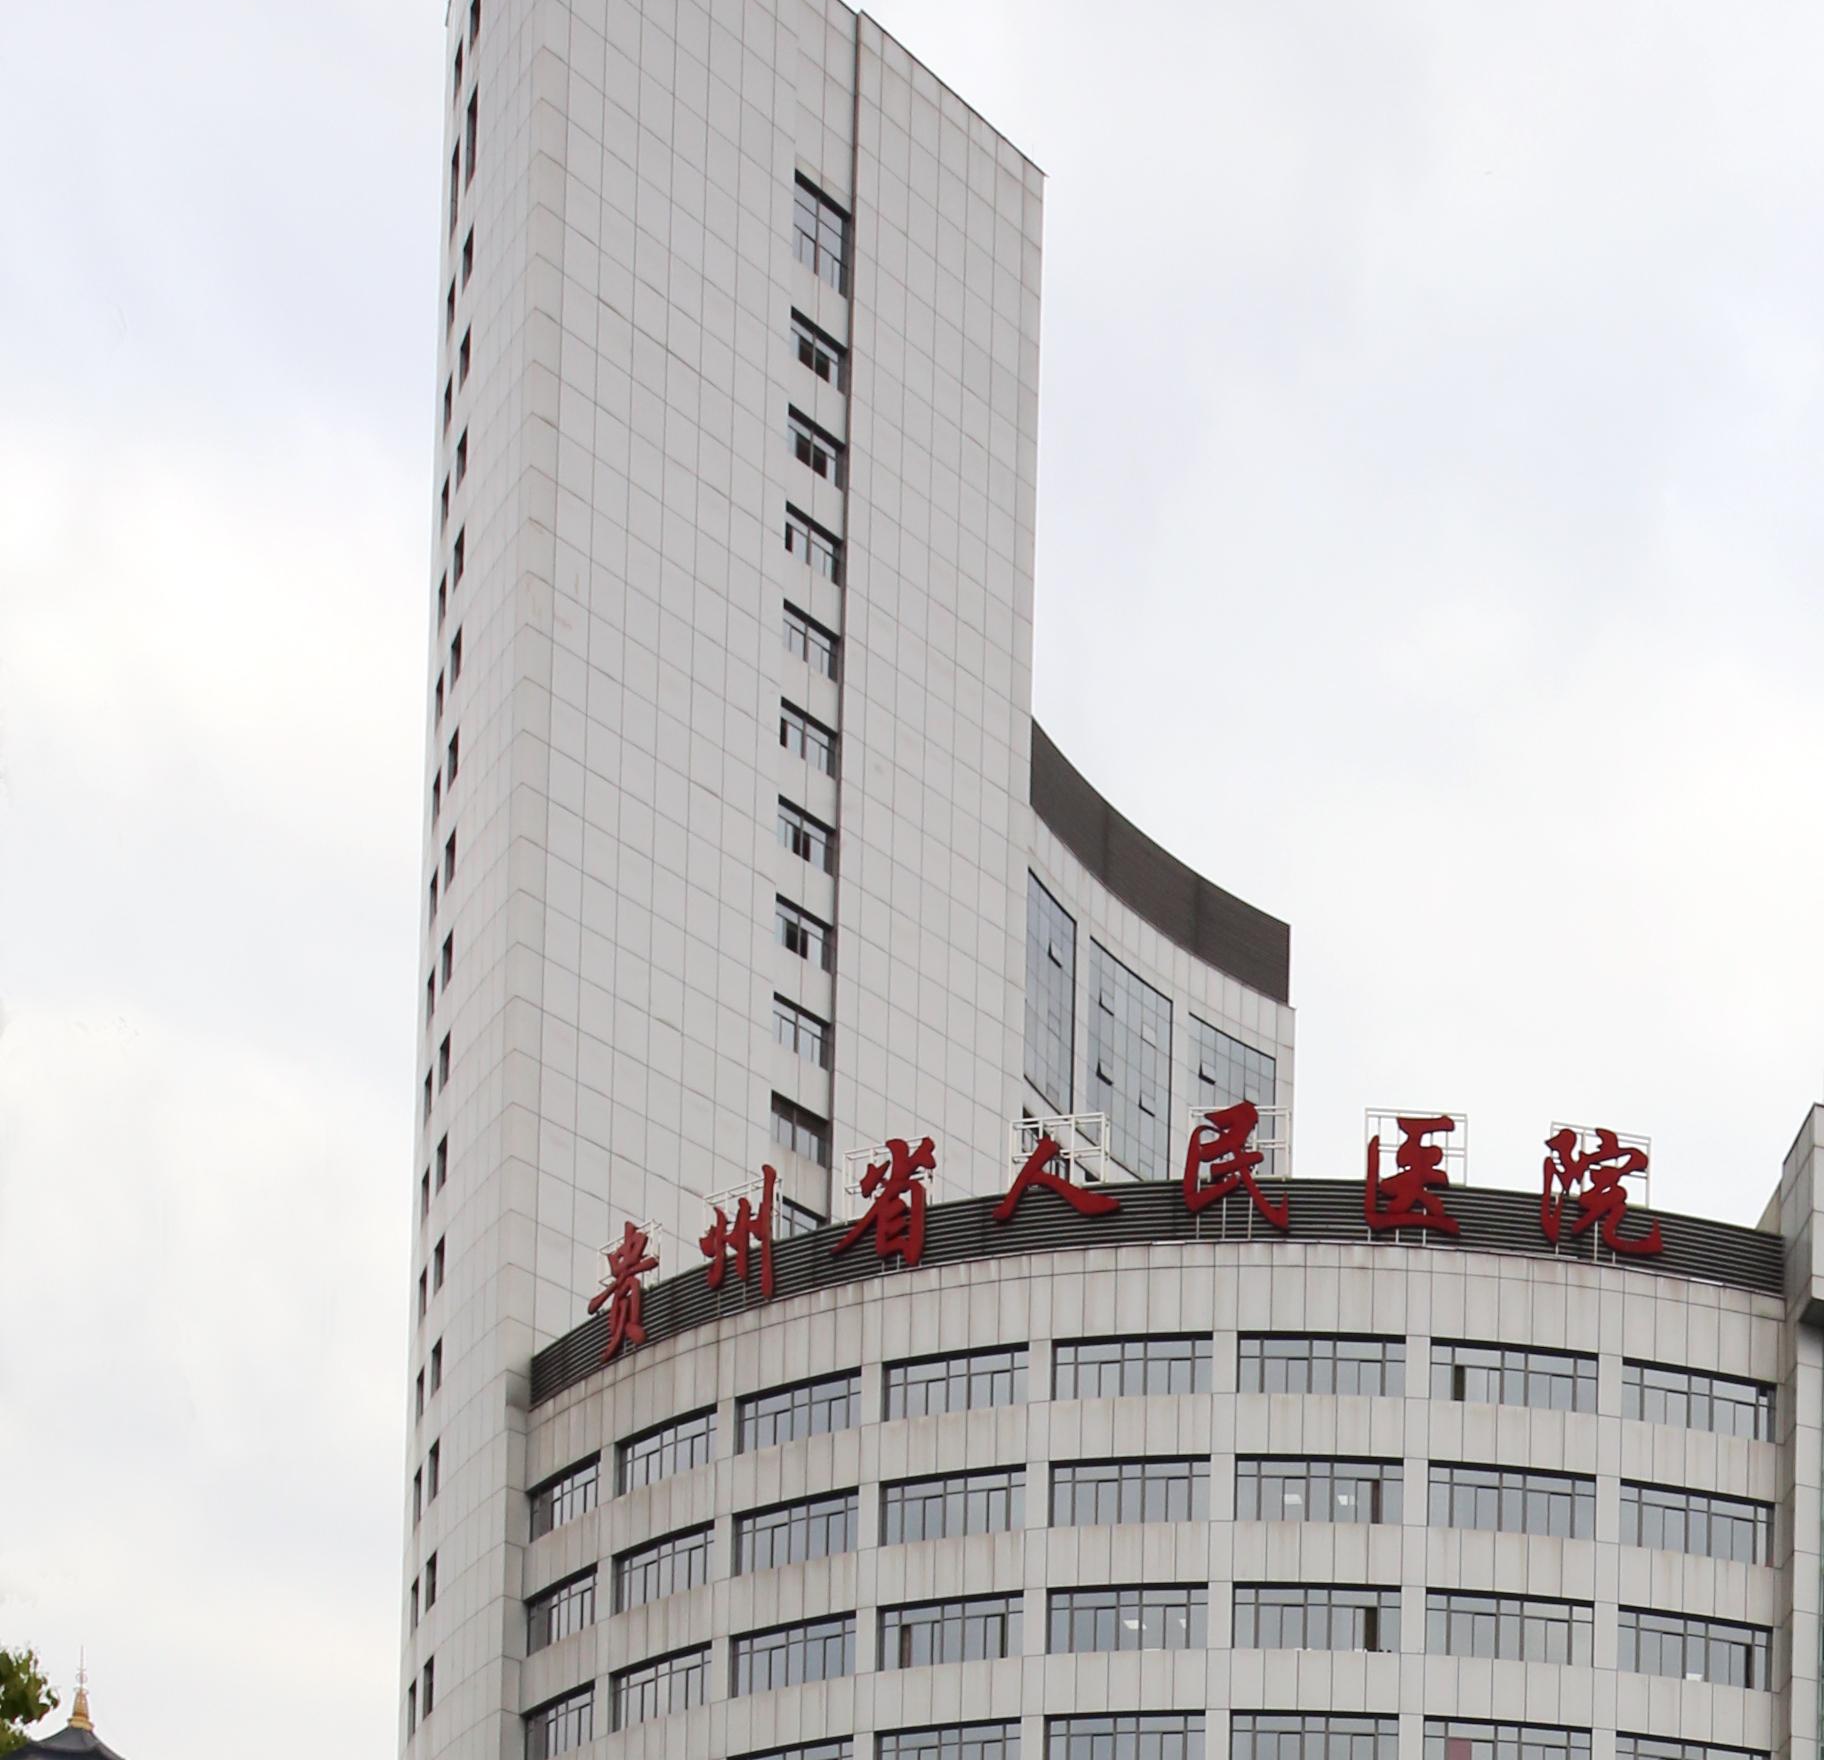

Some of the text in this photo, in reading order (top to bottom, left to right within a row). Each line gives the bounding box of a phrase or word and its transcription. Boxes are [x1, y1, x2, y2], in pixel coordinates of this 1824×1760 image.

[588, 1101, 1662, 1361] 贵州省人民医院
